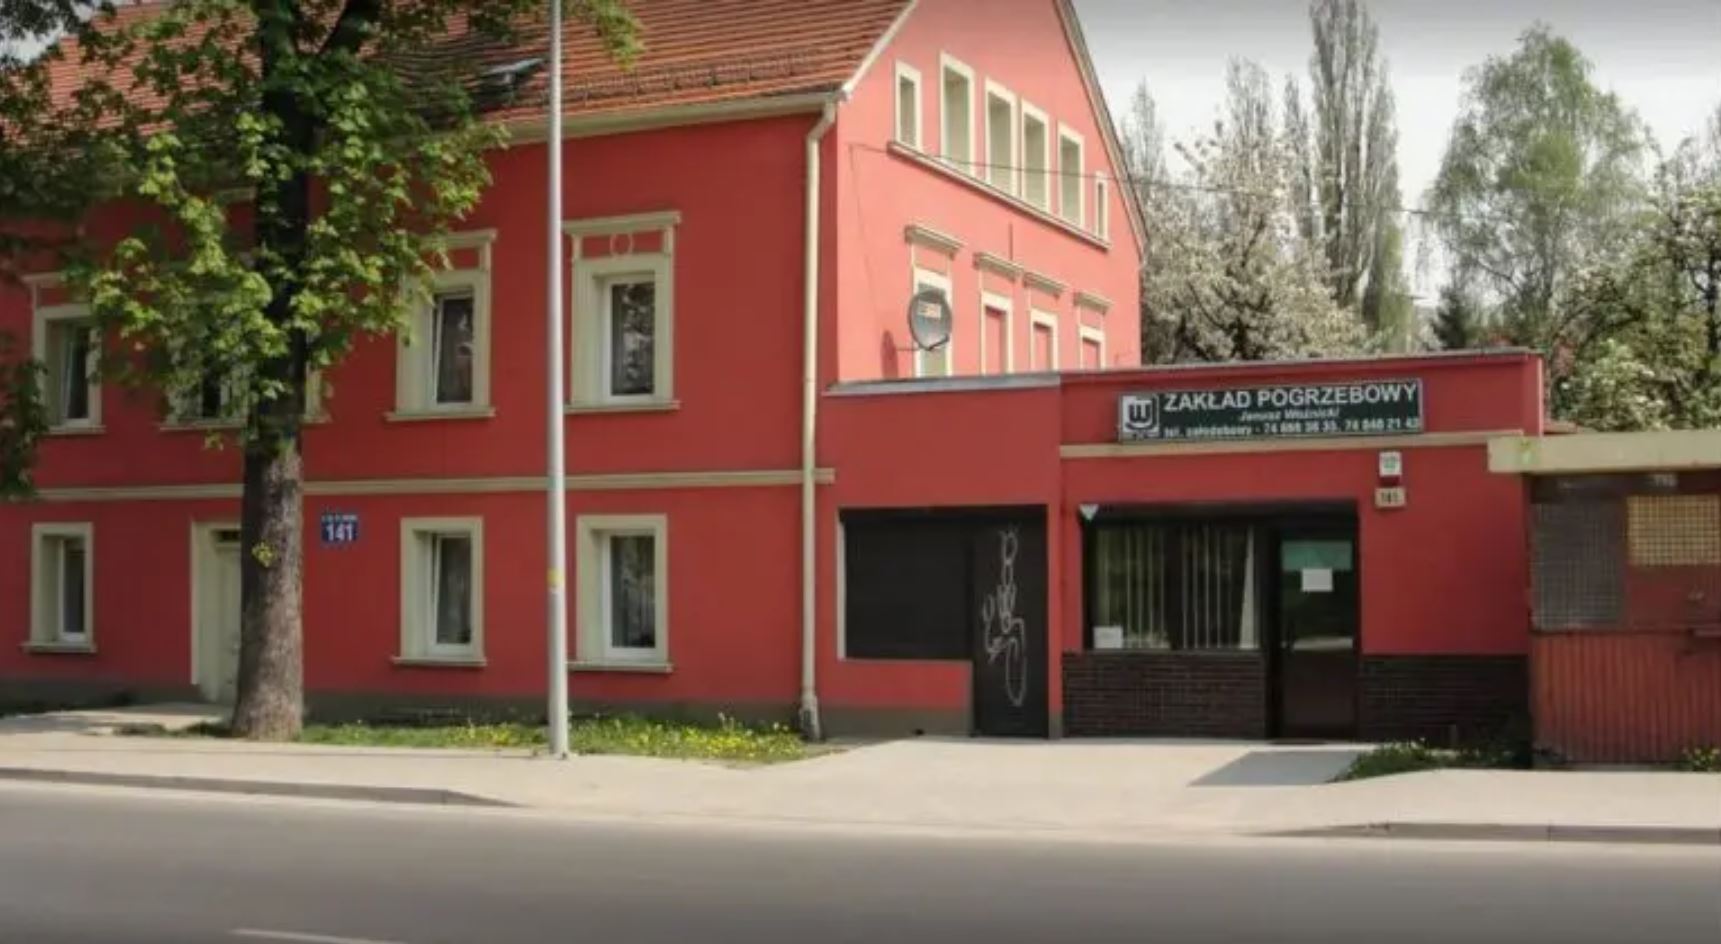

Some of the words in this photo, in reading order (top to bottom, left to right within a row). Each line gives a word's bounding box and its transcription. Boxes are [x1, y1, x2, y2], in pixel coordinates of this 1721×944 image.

[1164, 390, 1250, 411] ZAKŁAD
[1257, 384, 1417, 407] POGRZEBOWY
[325, 523, 353, 541] 141
